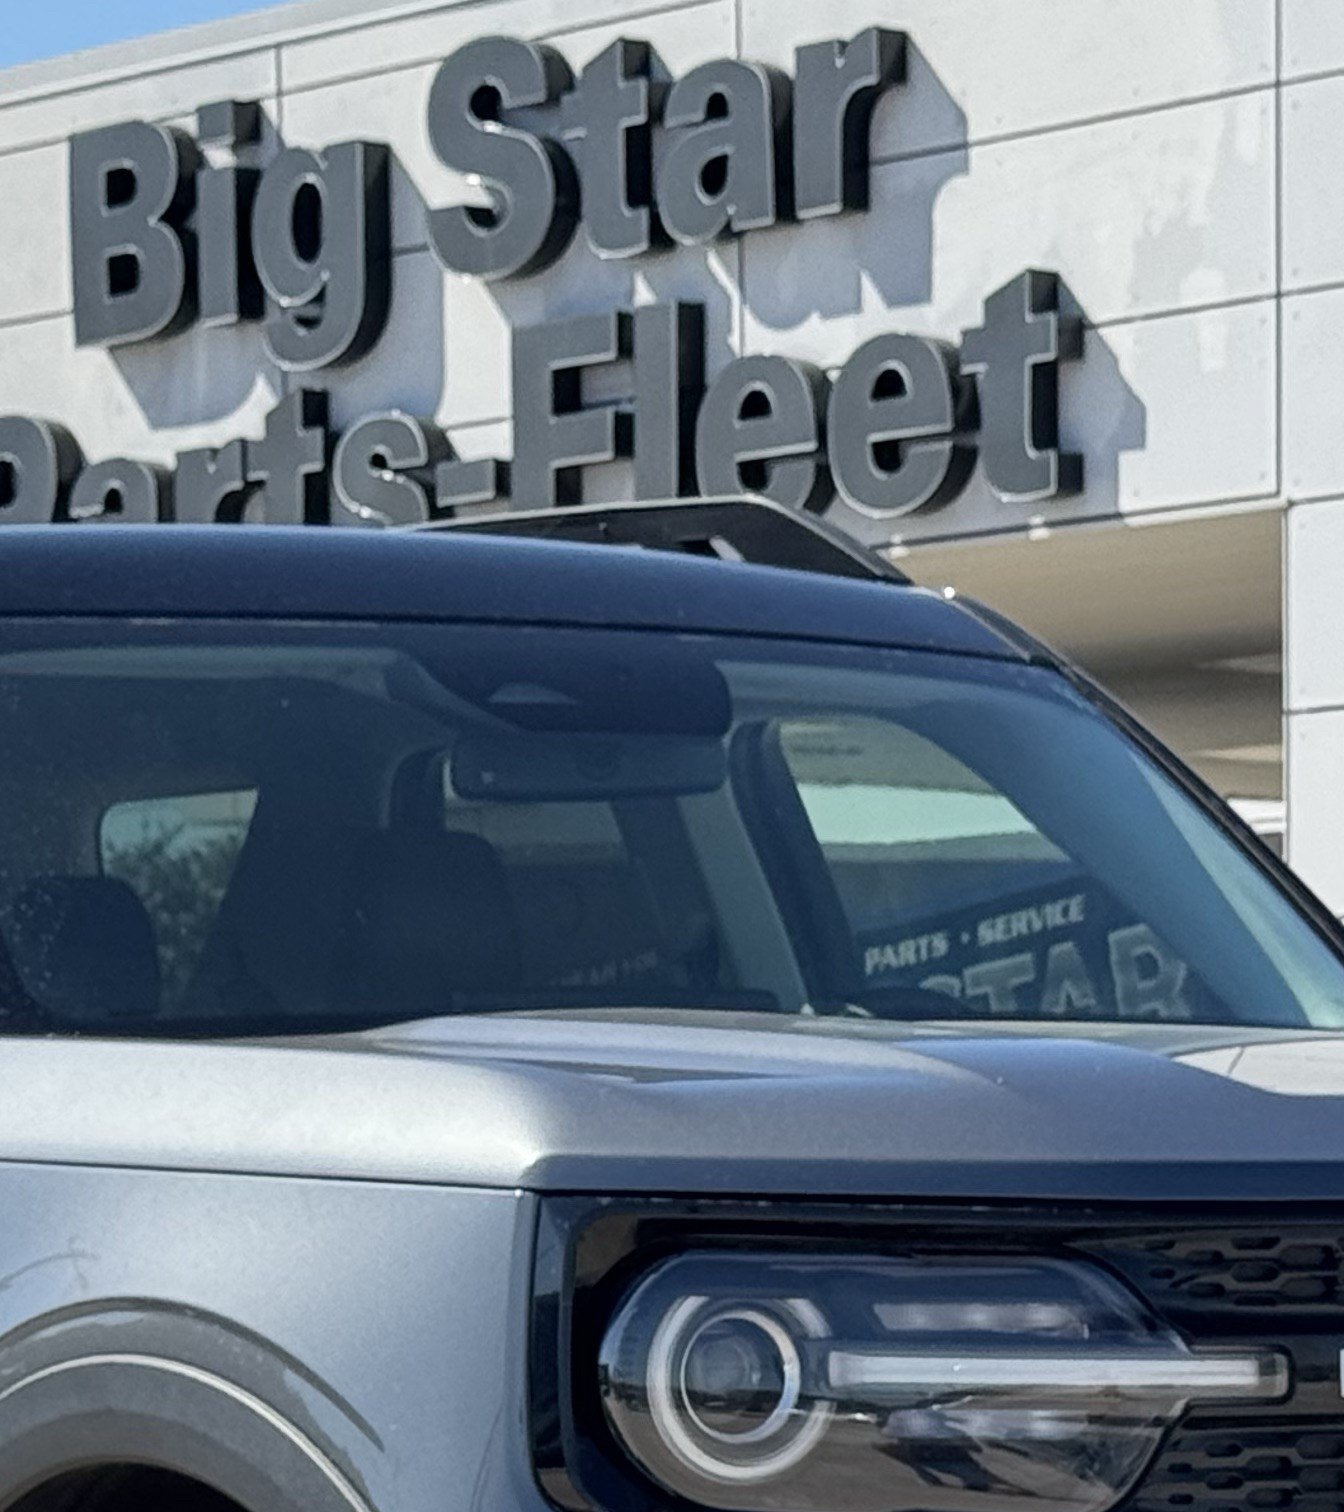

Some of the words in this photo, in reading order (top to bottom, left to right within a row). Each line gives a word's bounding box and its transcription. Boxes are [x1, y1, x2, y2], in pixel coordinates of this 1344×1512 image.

[67, 99, 391, 373] Big
[427, 27, 910, 282] Star
[864, 930, 950, 977] PARTS
[976, 893, 1086, 947] SERVICE
